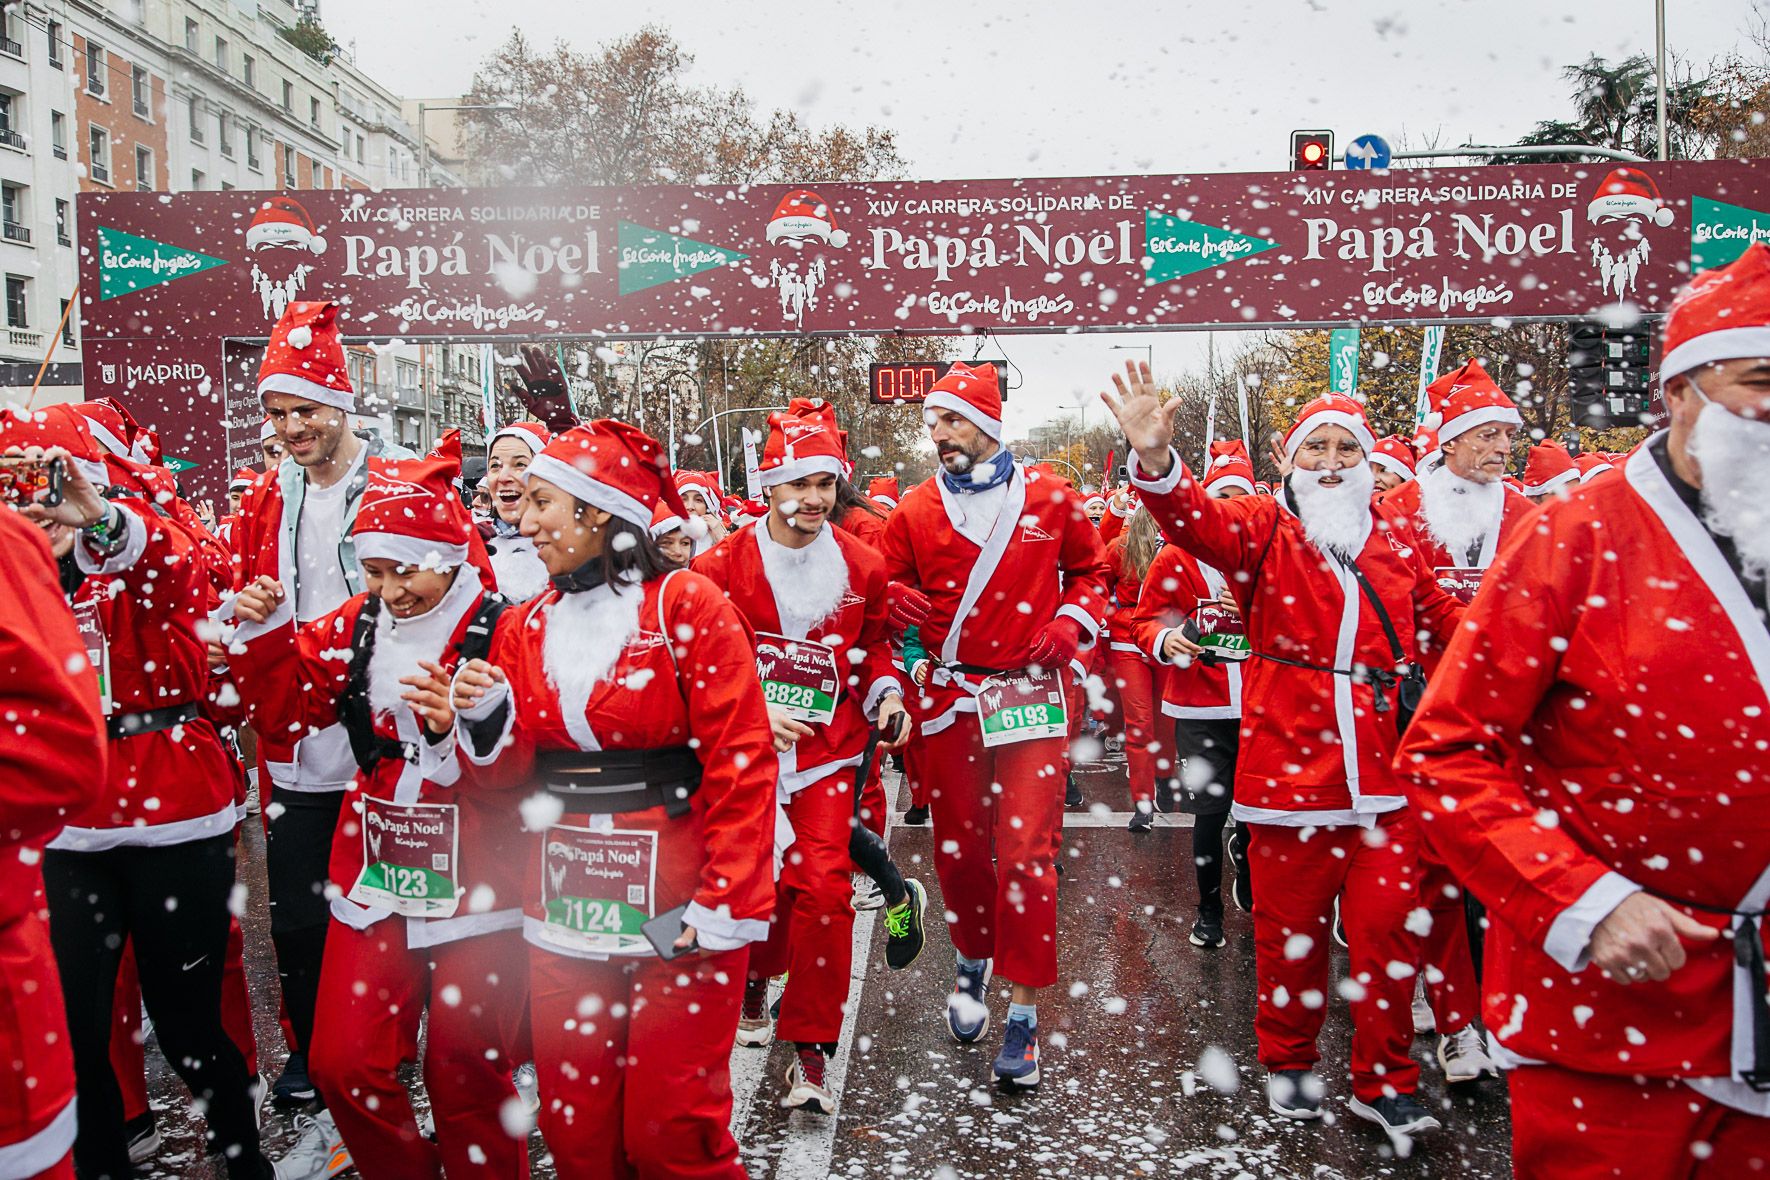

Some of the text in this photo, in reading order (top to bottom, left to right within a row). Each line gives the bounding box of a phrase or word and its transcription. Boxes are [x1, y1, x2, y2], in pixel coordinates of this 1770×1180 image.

[1303, 183, 1577, 205] XIV CARRERA SOLIDARIA DE
[340, 205, 600, 223] XIV CARRERA SOLIDARIA DE
[868, 195, 1134, 215] XIV CARRERA SOLIDARIA DE
[1302, 208, 1577, 273] Papá Noel
[1713, 223, 1748, 240] Corte
[340, 230, 602, 289] Papá Noel
[867, 220, 1135, 282] Papá Noel
[1002, 286, 1074, 321] Inglés
[1439, 276, 1513, 312] Inglés
[127, 363, 206, 381] MADRID
[233, 416, 244, 429] Bon
[232, 456, 254, 470] Joyeux
[1463, 579, 1482, 590] Pap
[77, 619, 98, 633] oel
[1217, 633, 1244, 649] 727
[764, 682, 815, 708] 8828
[1001, 704, 1049, 730] 6193
[385, 819, 444, 836] Papá Noel
[575, 847, 641, 866] Papá Noel
[380, 862, 429, 897] 7123
[561, 897, 623, 932] 7124
